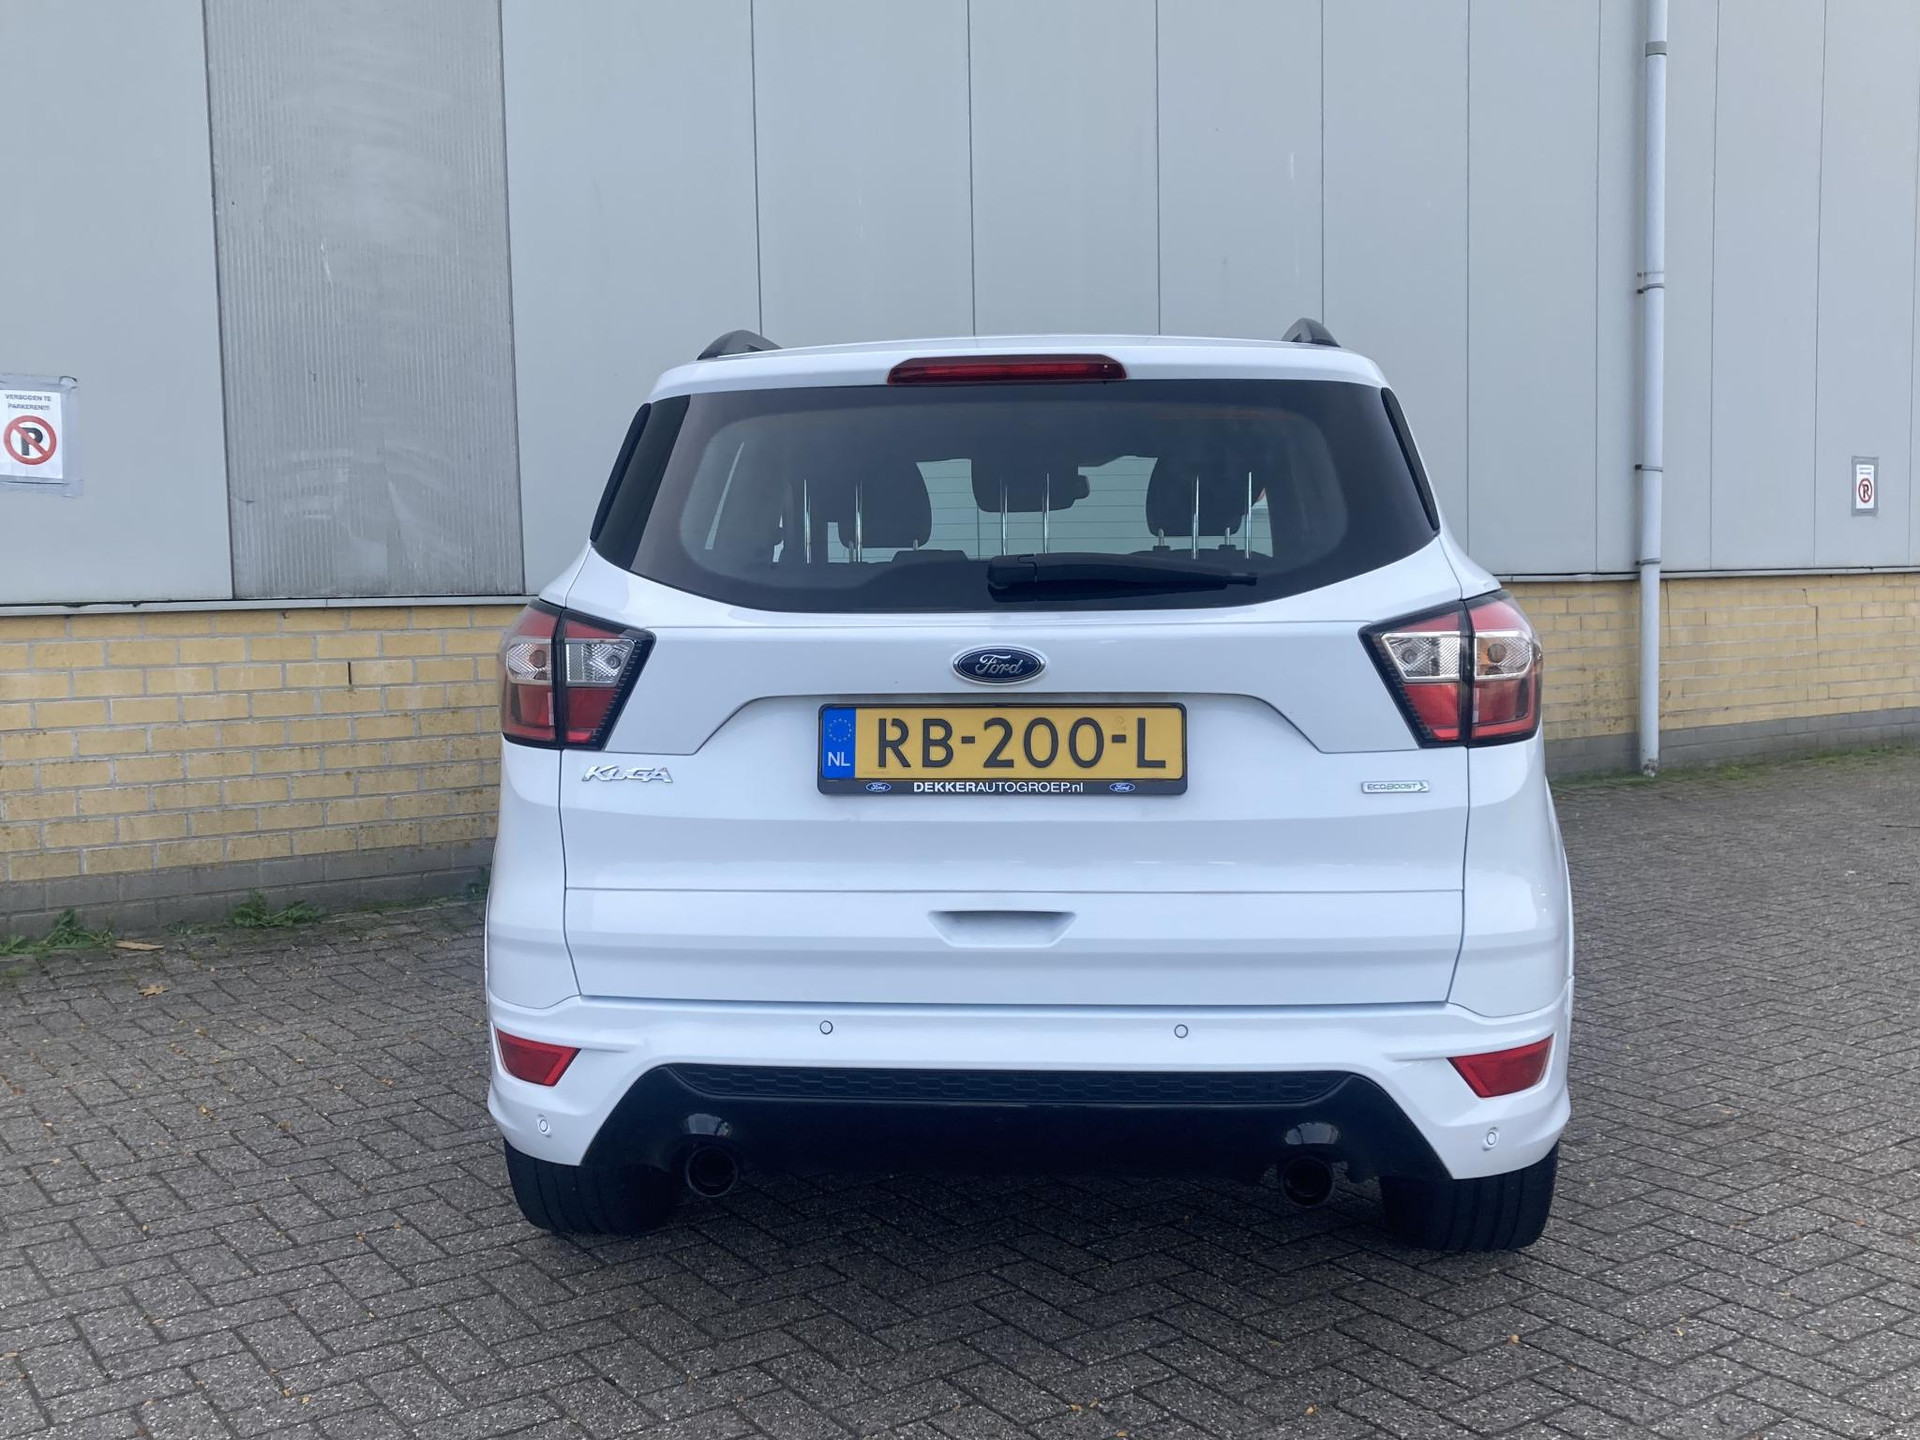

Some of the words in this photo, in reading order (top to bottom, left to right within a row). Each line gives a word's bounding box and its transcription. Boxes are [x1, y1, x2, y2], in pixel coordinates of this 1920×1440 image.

[974, 653, 1024, 675] Ford
[877, 716, 1167, 769] RB-200-L
[827, 751, 851, 767] NL
[582, 764, 674, 784] KUGA
[868, 783, 888, 791] Ford
[913, 781, 1084, 794] DEKKERAUTOGROEP.nl
[1112, 783, 1132, 792] Ford
[1366, 783, 1418, 791] ECOBOOST
